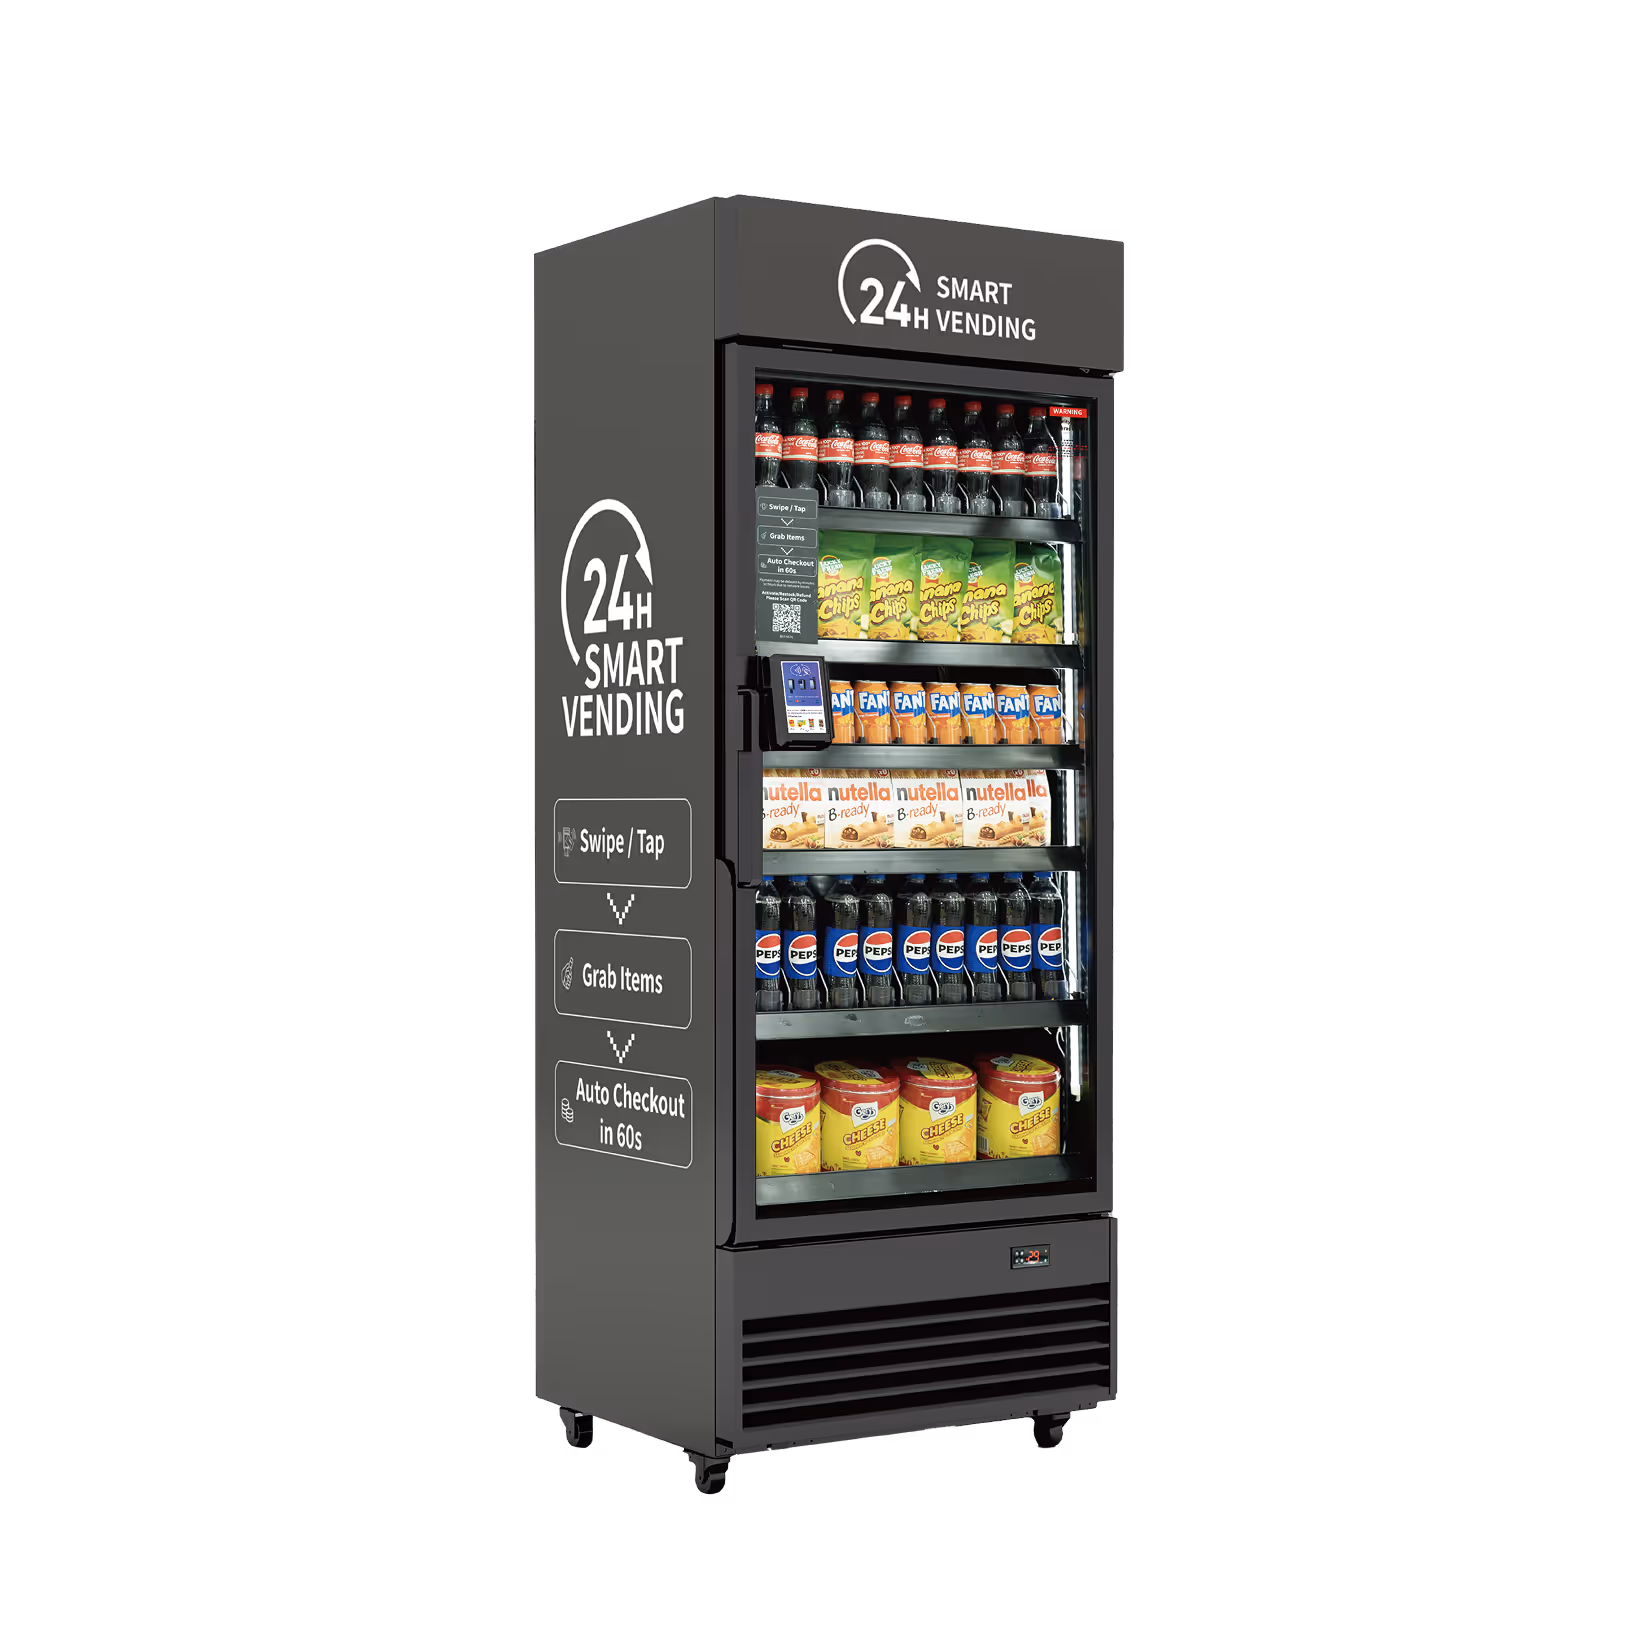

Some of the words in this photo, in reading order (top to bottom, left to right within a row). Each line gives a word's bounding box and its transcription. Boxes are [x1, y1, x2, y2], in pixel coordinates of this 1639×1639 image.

[859, 277, 929, 329] 24H
[936, 275, 1012, 305] SMART
[936, 309, 1036, 341] VENDING
[769, 503, 789, 511] Swipe
[794, 505, 806, 513] Tap
[767, 557, 782, 565] Auto
[783, 558, 814, 567] Checkout
[584, 554, 652, 634] 24H
[818, 593, 861, 621] Chips
[870, 596, 907, 625] Chips
[920, 597, 957, 625] Chips
[961, 600, 1000, 627] Chips
[1018, 599, 1053, 627] Chips
[584, 636, 683, 689] SMART
[562, 688, 684, 737] VENDING
[828, 782, 891, 801] nutella
[897, 782, 959, 801] nutella
[966, 782, 1026, 801] nutella
[580, 827, 624, 859] Swipe
[627, 827, 634, 858] /
[637, 829, 665, 860] Tap
[836, 948, 857, 958] PEP
[1003, 943, 1030, 953] PEPS
[1040, 943, 1062, 952] PEP
[582, 963, 617, 990] Grab
[620, 965, 663, 994] Items
[576, 1077, 609, 1105] Auto
[613, 1082, 685, 1118] Checkout
[600, 1118, 613, 1145] in
[616, 1122, 642, 1151] 60s
[842, 1118, 886, 1145] CHEESE
[921, 1113, 963, 1140] CHEESE
[1010, 1107, 1051, 1134] CHEESE
[771, 1122, 812, 1153] CHEESE
